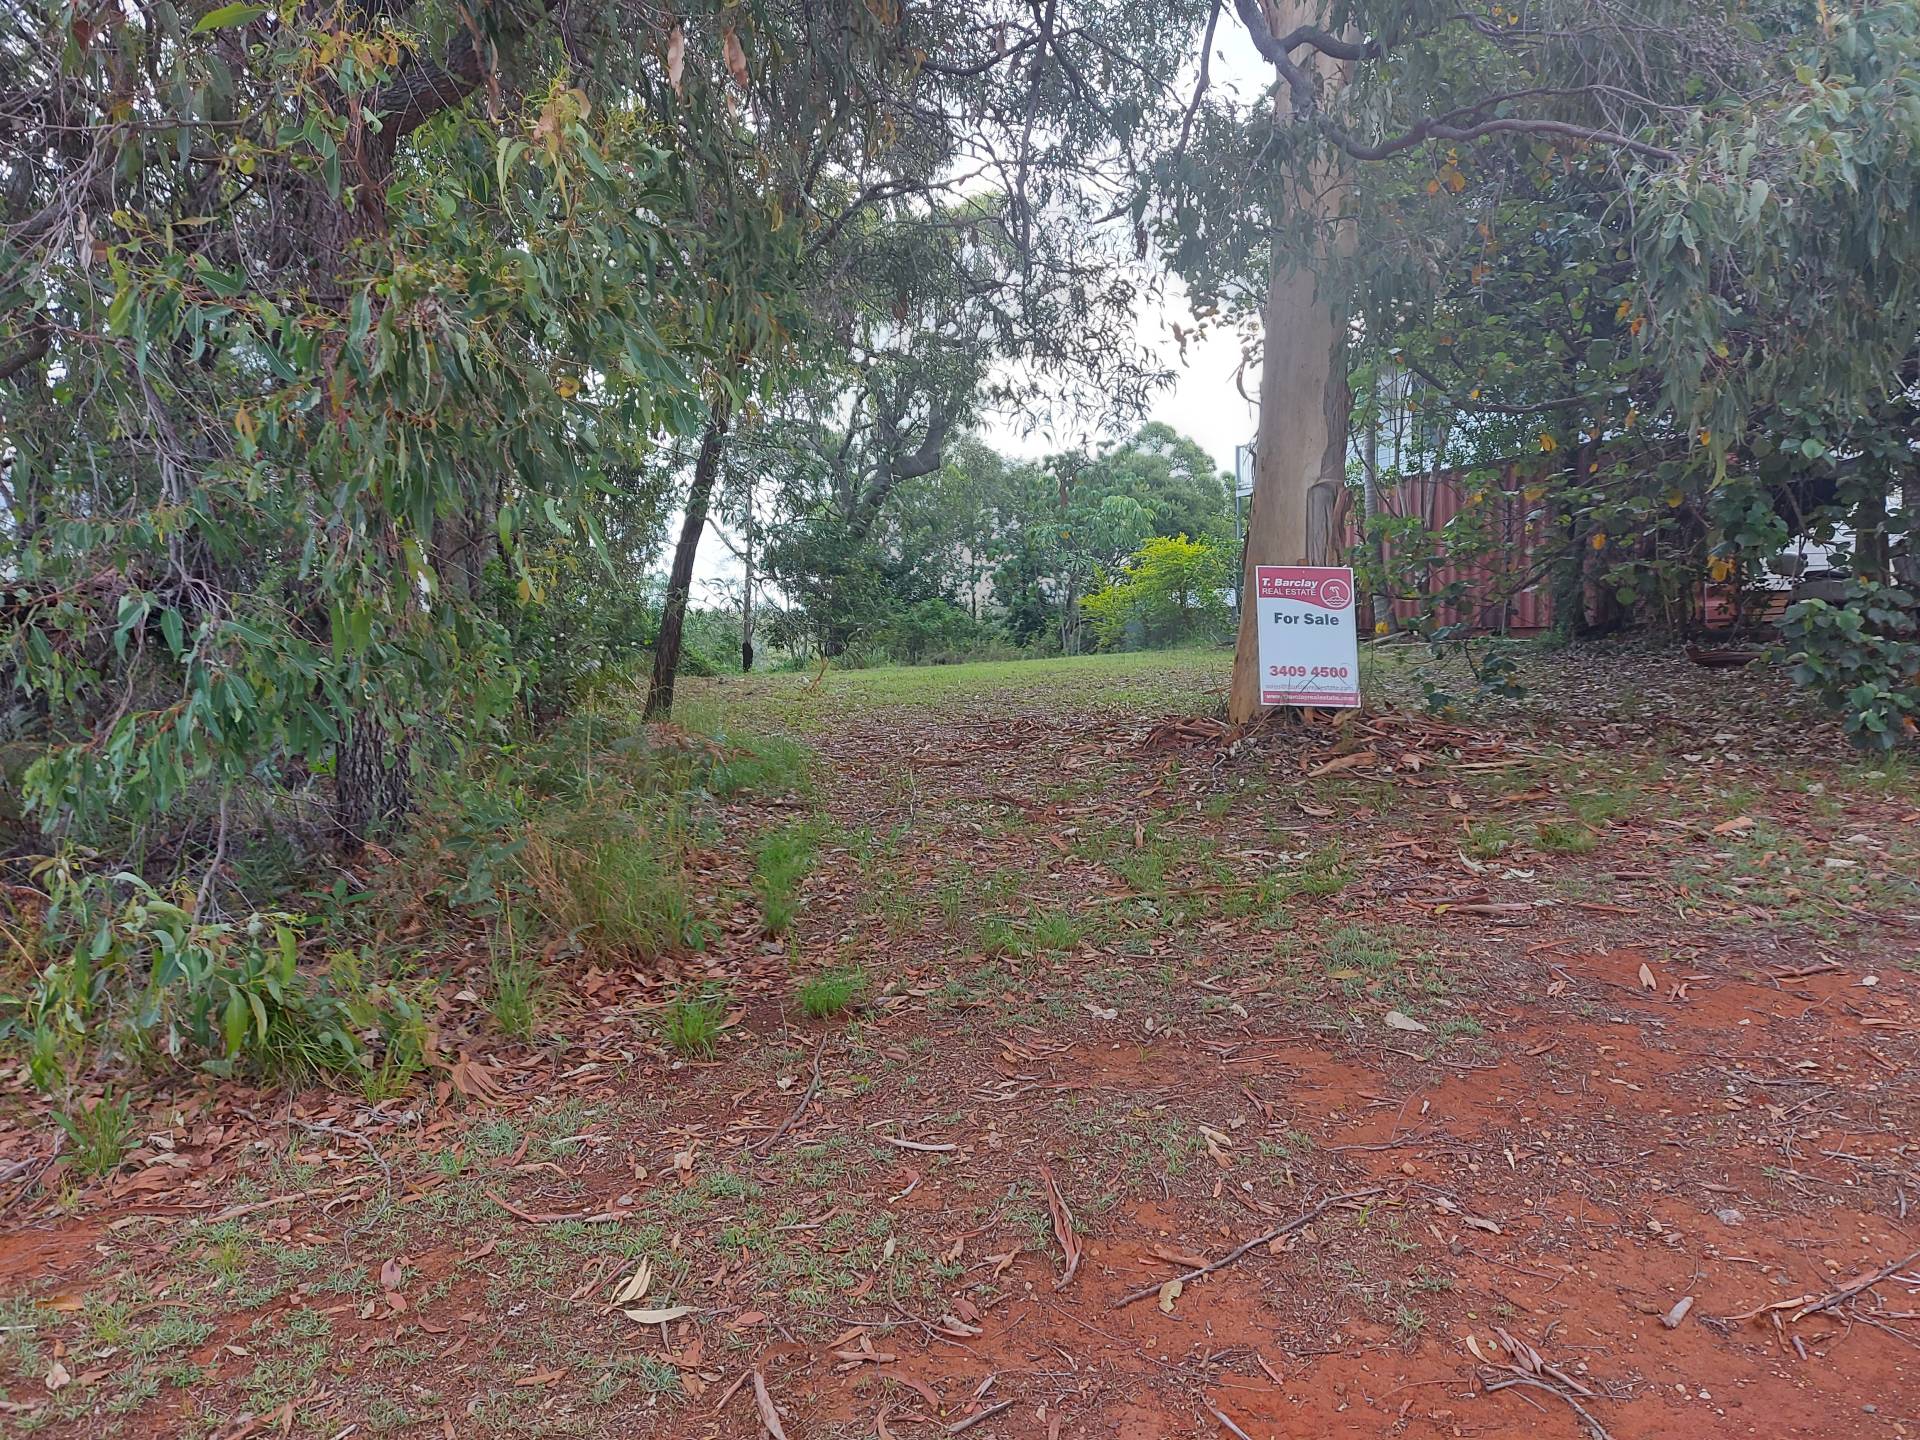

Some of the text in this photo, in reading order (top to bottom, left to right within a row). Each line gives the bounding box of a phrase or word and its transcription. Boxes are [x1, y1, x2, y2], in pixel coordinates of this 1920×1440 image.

[1262, 578, 1318, 589] T. Barclay
[1274, 612, 1339, 625] For Sale
[1269, 665, 1348, 678] 3409 4500
